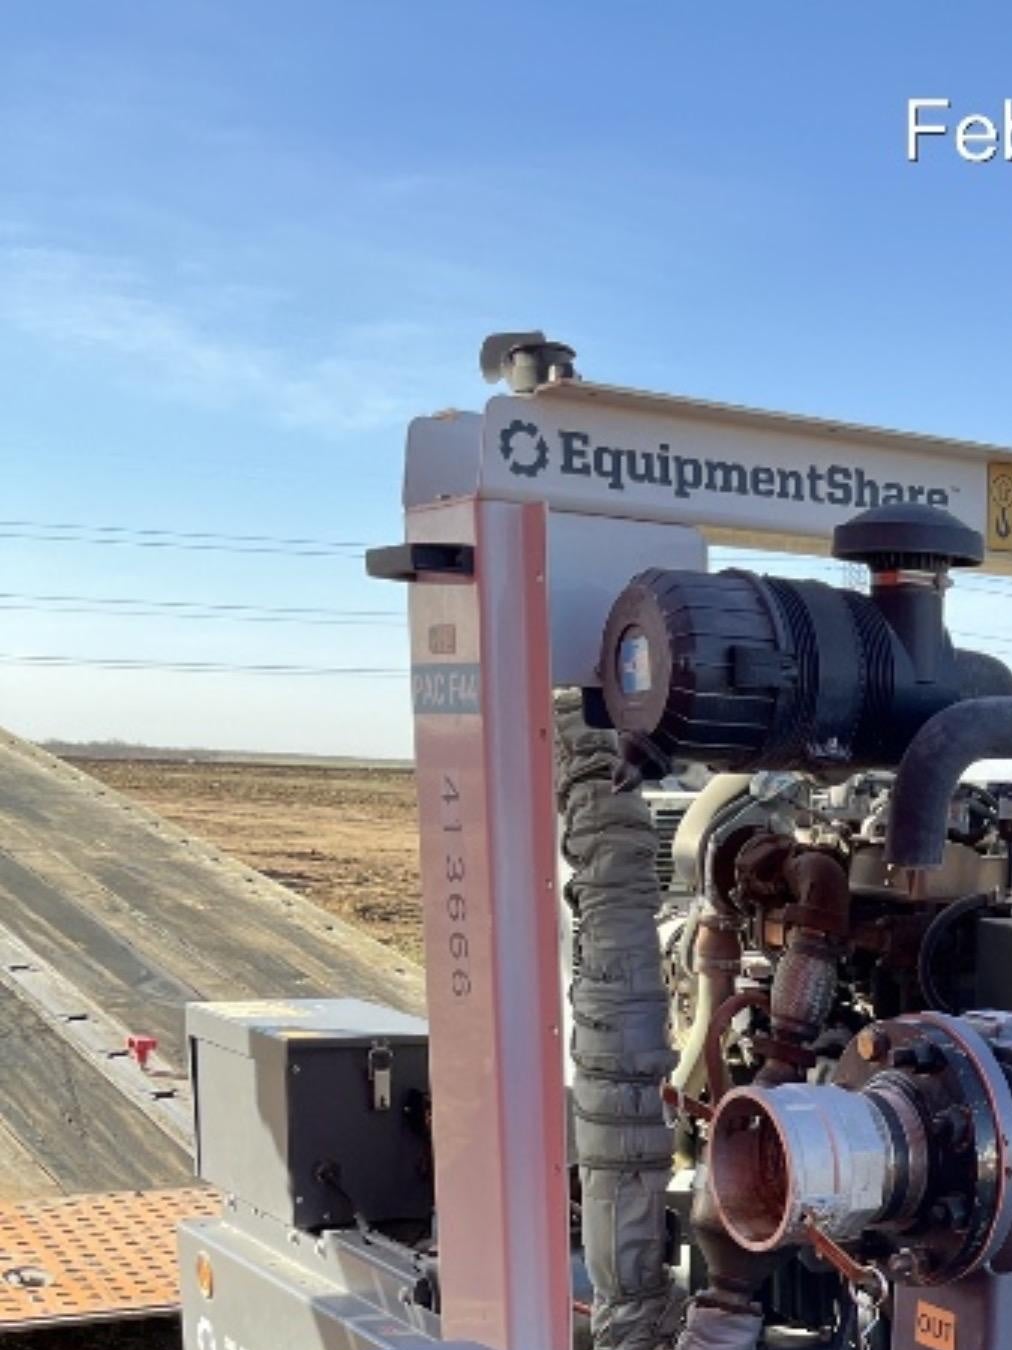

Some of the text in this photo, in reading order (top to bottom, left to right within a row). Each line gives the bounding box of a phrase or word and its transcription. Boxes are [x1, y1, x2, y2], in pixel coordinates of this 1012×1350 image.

[557, 428, 950, 509] EquipmentShare
[440, 774, 472, 999] 413666
[918, 1312, 953, 1343] OUT
